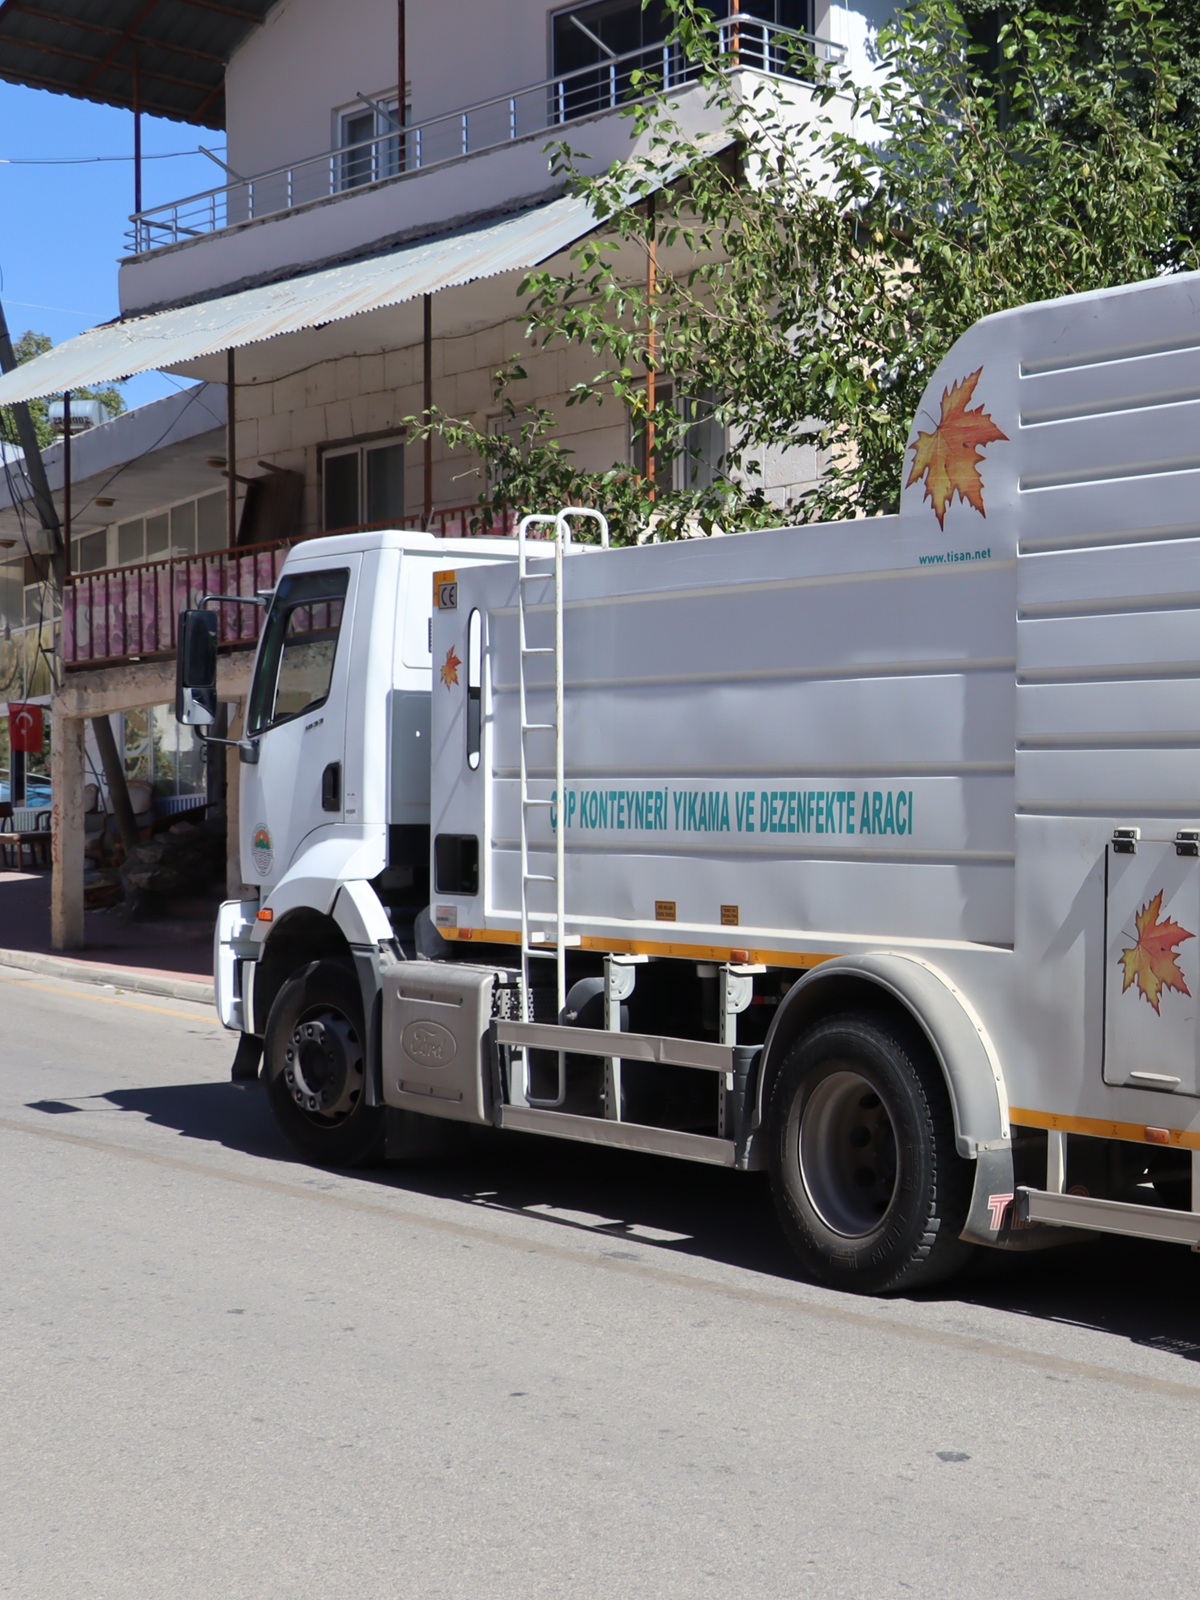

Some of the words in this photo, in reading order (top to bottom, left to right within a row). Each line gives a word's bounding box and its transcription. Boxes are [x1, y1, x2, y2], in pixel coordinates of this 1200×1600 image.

[919, 547, 992, 565] www.tisan.net
[441, 586, 455, 606] CE
[579, 786, 669, 831] KONTEYNERİ
[673, 791, 731, 832] YIKAMA
[735, 791, 755, 833] VE
[760, 791, 855, 834] DEZENFEKTE
[859, 790, 913, 836] ARACI
[410, 1027, 446, 1060] Ford
